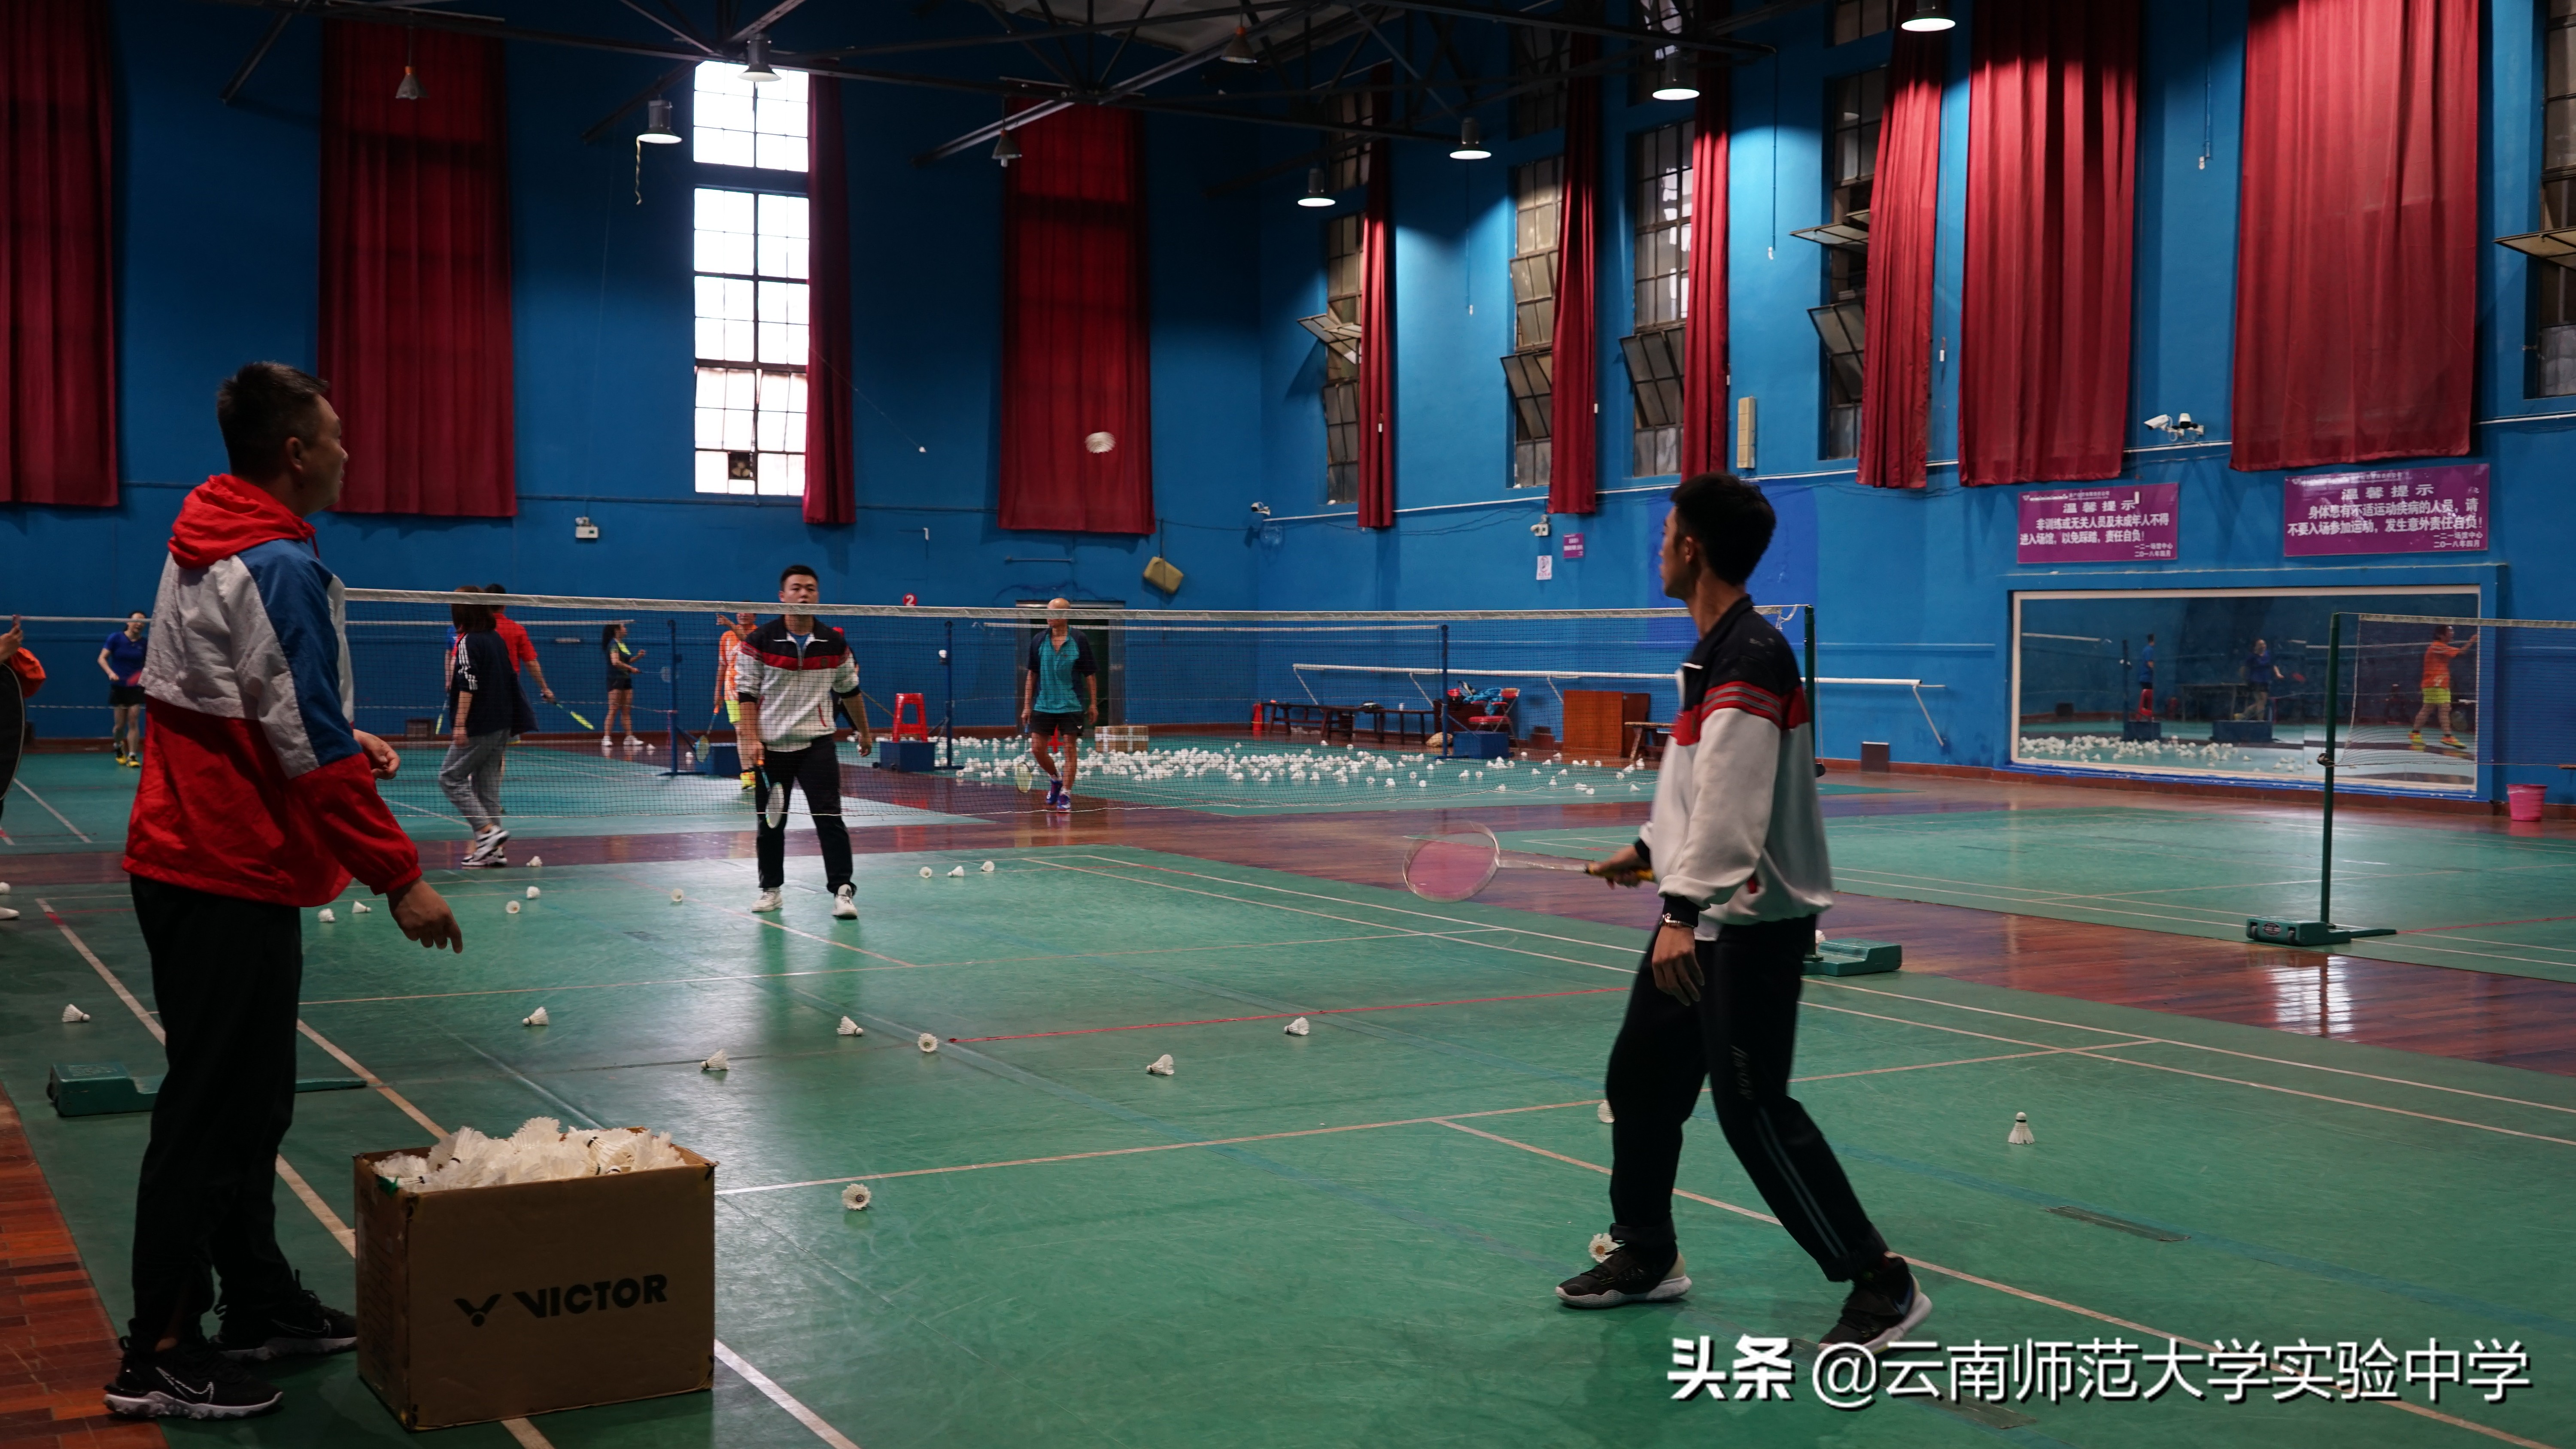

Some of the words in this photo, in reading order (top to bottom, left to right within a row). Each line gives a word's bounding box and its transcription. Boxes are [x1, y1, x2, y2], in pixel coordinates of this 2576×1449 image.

[2341, 484, 2435, 500] 温馨提示
[2063, 500, 2136, 513] 温馨提示
[905, 594, 915, 606] 2
[513, 1273, 667, 1319] VICTOR
